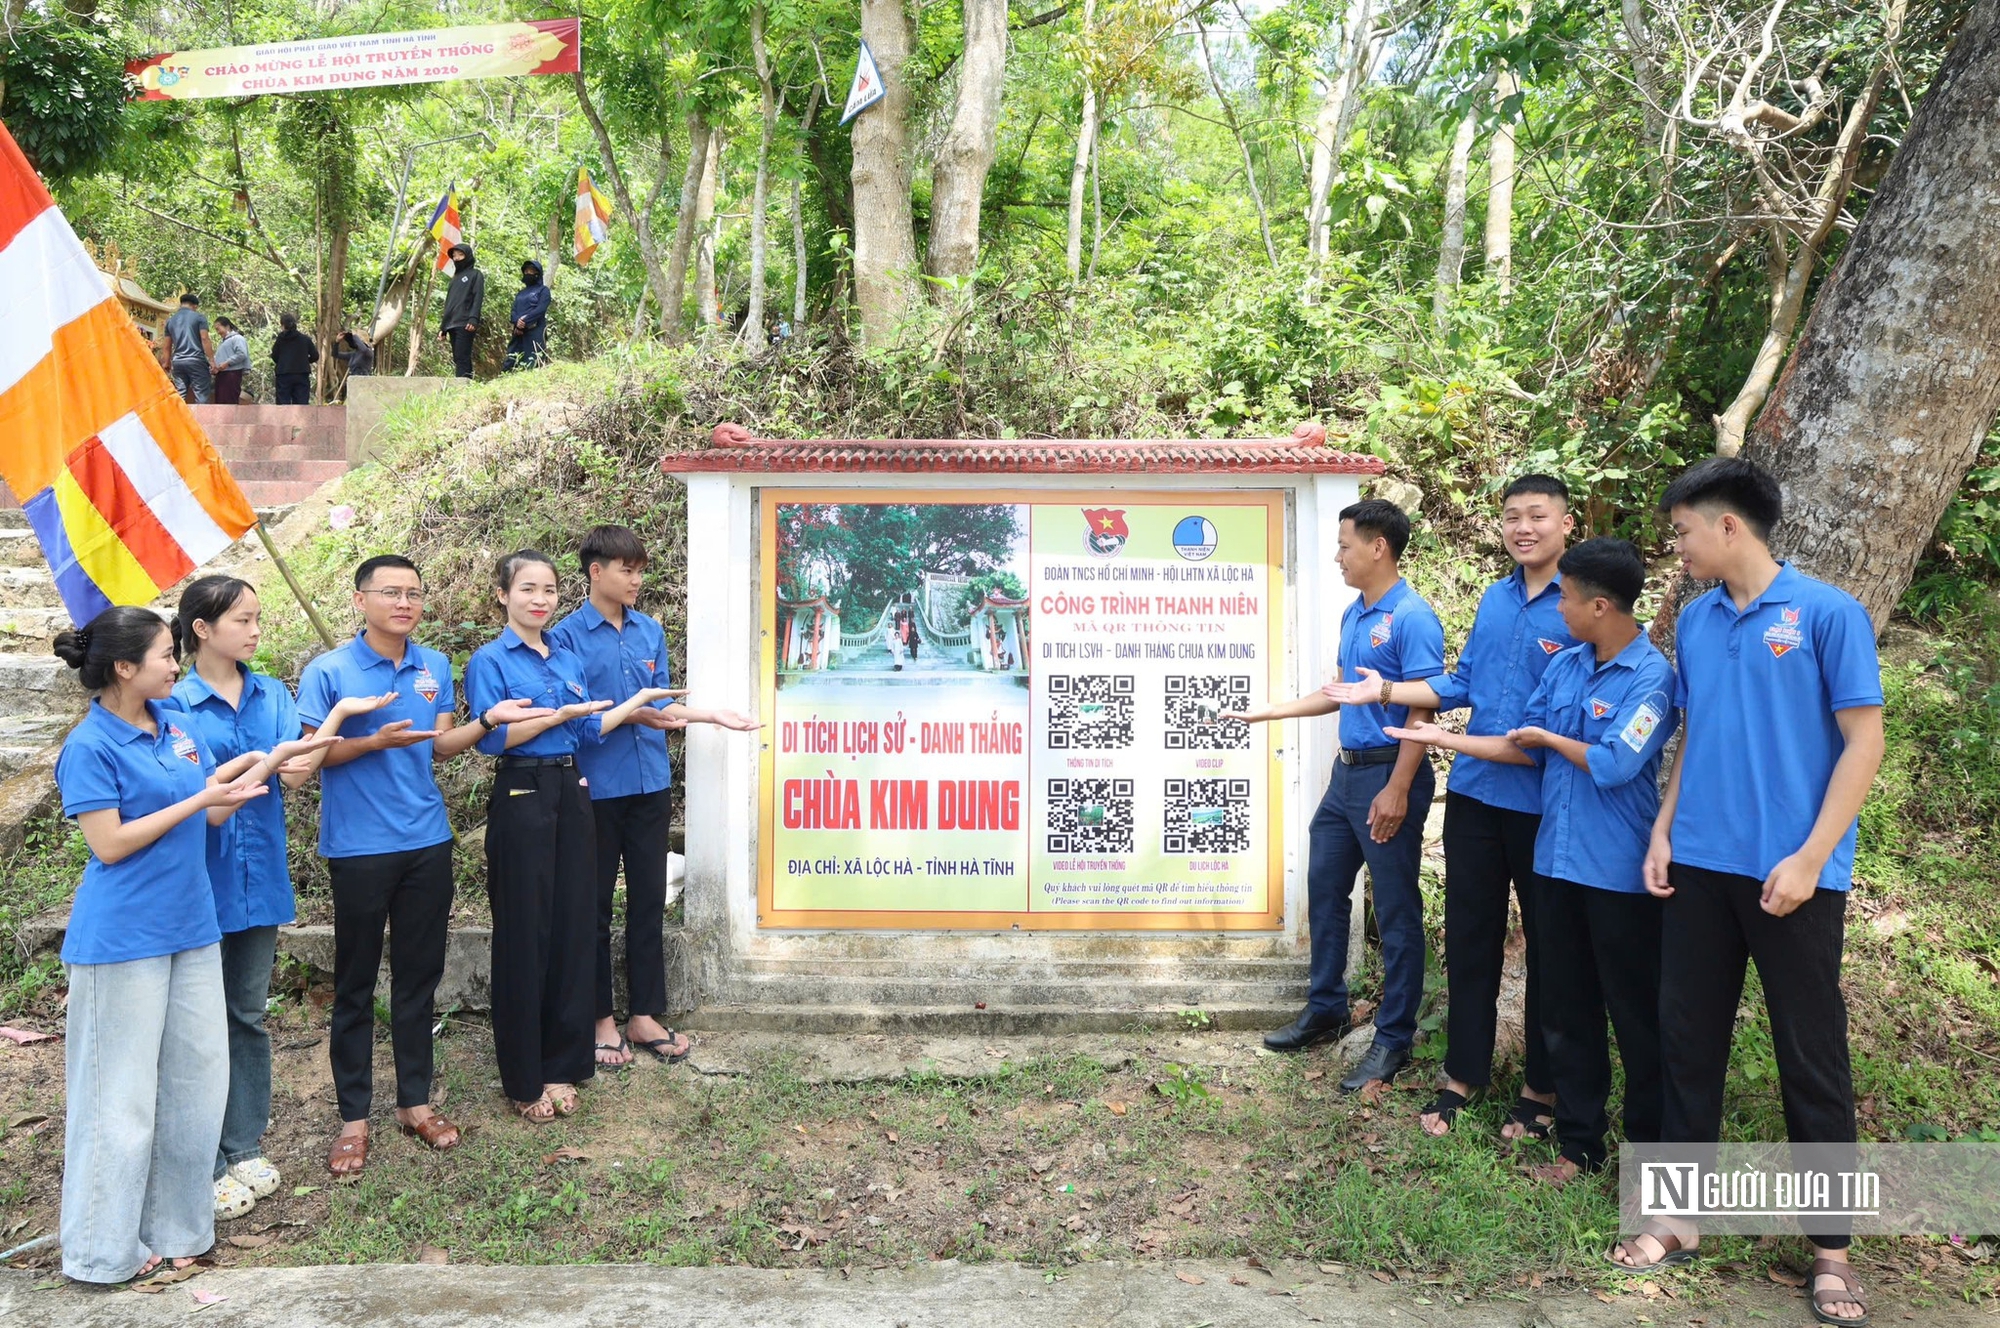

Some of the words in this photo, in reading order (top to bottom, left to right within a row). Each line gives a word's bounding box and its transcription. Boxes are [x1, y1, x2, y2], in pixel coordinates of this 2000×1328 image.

[359, 38, 379, 47] NAM
[205, 63, 250, 76] CHÀO
[255, 60, 303, 73] MỪNG
[309, 53, 326, 69] LỄ
[332, 52, 361, 67] HỘI
[366, 46, 432, 62] TRUYỀN
[437, 40, 495, 57] THỐNG
[242, 75, 288, 90] CHÙA
[294, 74, 324, 86] KIM
[329, 69, 376, 83] DUNG
[382, 65, 419, 79] NĂM
[424, 64, 459, 76] 2026
[1044, 564, 1069, 581] ĐOÀN
[1072, 567, 1095, 581] TNCS
[1098, 562, 1110, 581] HỒ
[1112, 563, 1128, 581] CHÍ
[1130, 567, 1154, 581] MINH
[1163, 565, 1178, 584] HỘI
[1181, 568, 1204, 582] LHTN
[1207, 565, 1220, 581] XÃ
[1222, 565, 1239, 584] LỘC
[1241, 565, 1254, 581] HÀ
[1041, 591, 1095, 615] CÔNG
[1101, 591, 1149, 615] TRÌNH
[1155, 596, 1213, 615] THANH
[1220, 591, 1258, 615] NIÊN
[1103, 622, 1126, 634] QR
[1196, 622, 1226, 632] TIN
[1043, 643, 1052, 659] DI
[1079, 643, 1102, 659] LSVH
[1115, 643, 1141, 659] DANH
[1207, 643, 1226, 659] KIM
[1229, 643, 1255, 659] DUNG
[782, 721, 798, 753] DI
[803, 714, 838, 753] TÍCH
[843, 721, 878, 761] LỊCH
[883, 710, 906, 754] SỬ
[921, 722, 964, 754] DANH
[969, 710, 1022, 754] THẮNG
[1085, 758, 1094, 768] TIN
[1095, 758, 1101, 768] DI
[1195, 759, 1211, 768] VIDEO
[1212, 759, 1224, 768] CLIP
[783, 769, 861, 830] CHÙA
[870, 780, 928, 830] KIM
[938, 780, 1020, 831] DUNG
[788, 859, 812, 878] ĐỊA
[815, 855, 841, 875] CHỈ:
[843, 857, 863, 875] XÃ
[866, 857, 891, 878] LỘC
[894, 857, 913, 875] HÀ
[925, 856, 957, 875] TỈNH
[961, 857, 980, 875] HÀ
[983, 857, 1014, 876] TĨNH
[1053, 860, 1069, 871] VIDEO
[1189, 860, 1197, 871] DU
[1062, 882, 1086, 892] khách
[1088, 883, 1100, 892] vui
[1156, 882, 1168, 894] QR
[1241, 883, 1252, 892] tin
[1052, 897, 1080, 905] (Please
[1102, 897, 1115, 905] the
[1117, 897, 1130, 906] QR
[1131, 897, 1149, 905] code
[1161, 897, 1177, 905] find
[1194, 897, 1245, 905] information)
